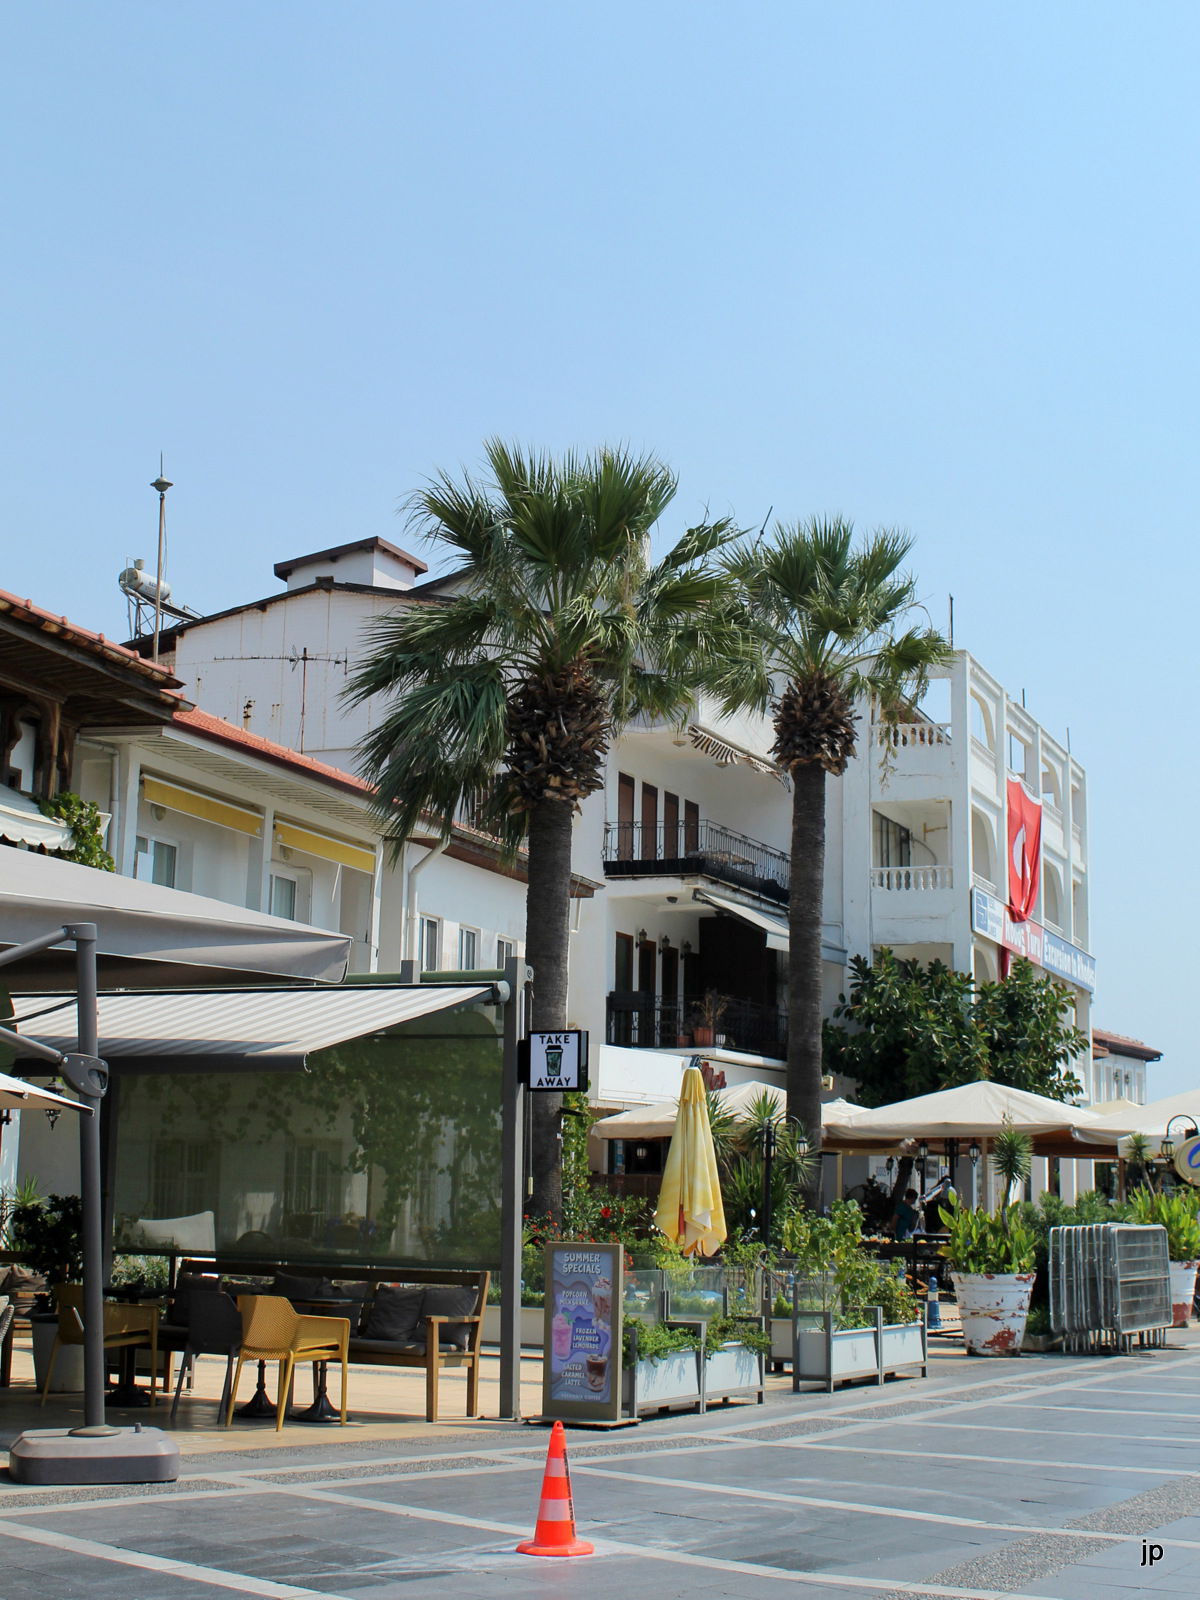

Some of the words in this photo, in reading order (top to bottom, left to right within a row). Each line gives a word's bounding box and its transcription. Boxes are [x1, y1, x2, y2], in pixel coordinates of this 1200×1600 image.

[539, 1035, 571, 1044] TAKE
[537, 1077, 571, 1086] AWAY
[564, 1253, 600, 1263] SUMMER
[562, 1264, 602, 1274] SPECIALS
[565, 1363, 583, 1371] SALTED
[561, 1371, 586, 1379] CARAMEL
[564, 1378, 581, 1386] LATTE
